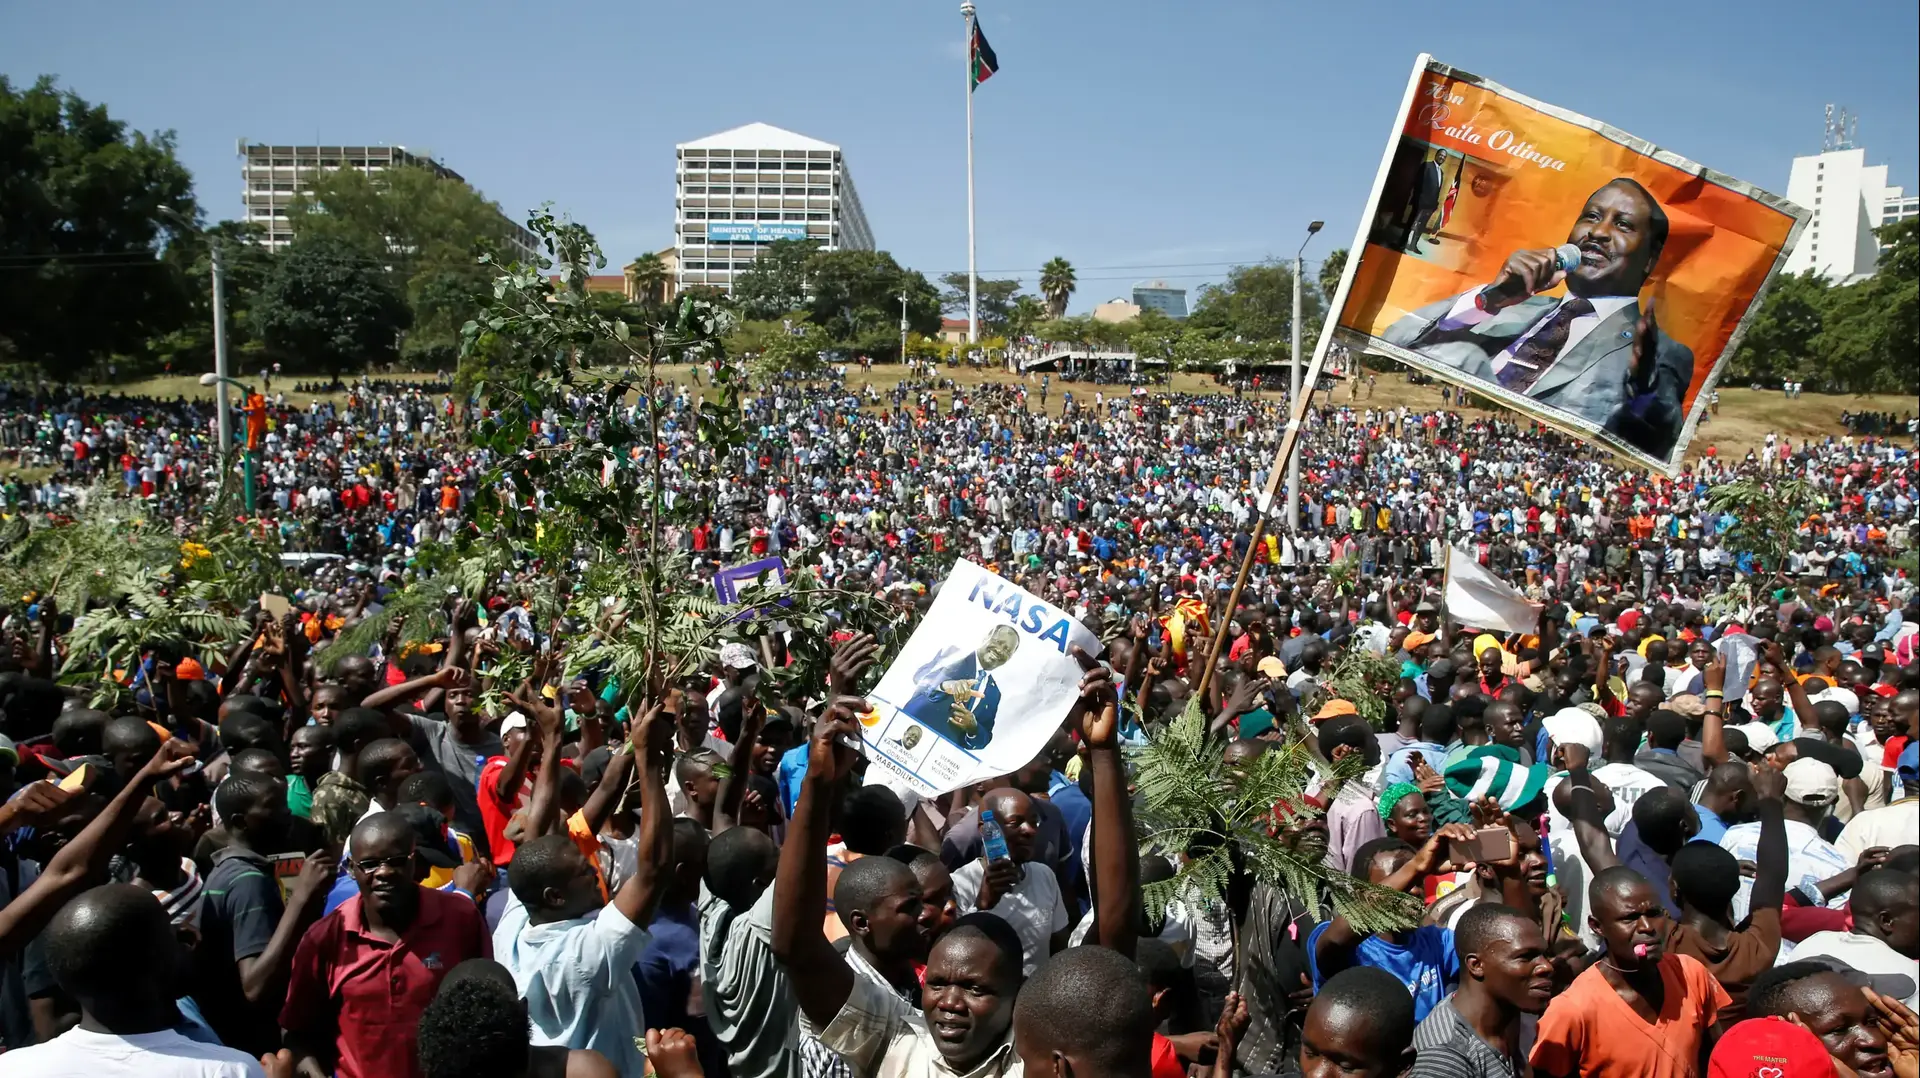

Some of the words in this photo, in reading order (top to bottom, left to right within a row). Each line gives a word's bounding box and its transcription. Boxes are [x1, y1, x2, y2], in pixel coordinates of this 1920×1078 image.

[1424, 81, 1464, 106] Hon
[1418, 102, 1482, 146] Raila
[1487, 129, 1567, 172] Odinga
[968, 574, 1071, 653] NASA
[883, 737, 898, 750] RAILA
[898, 748, 919, 764] AMOLO
[886, 749, 908, 765] ODINGA
[940, 754, 960, 771] STEPHEN
[874, 754, 920, 787] MABADILIKO
[931, 765, 953, 782] MUSYOK
[934, 759, 958, 777] KALONZO
